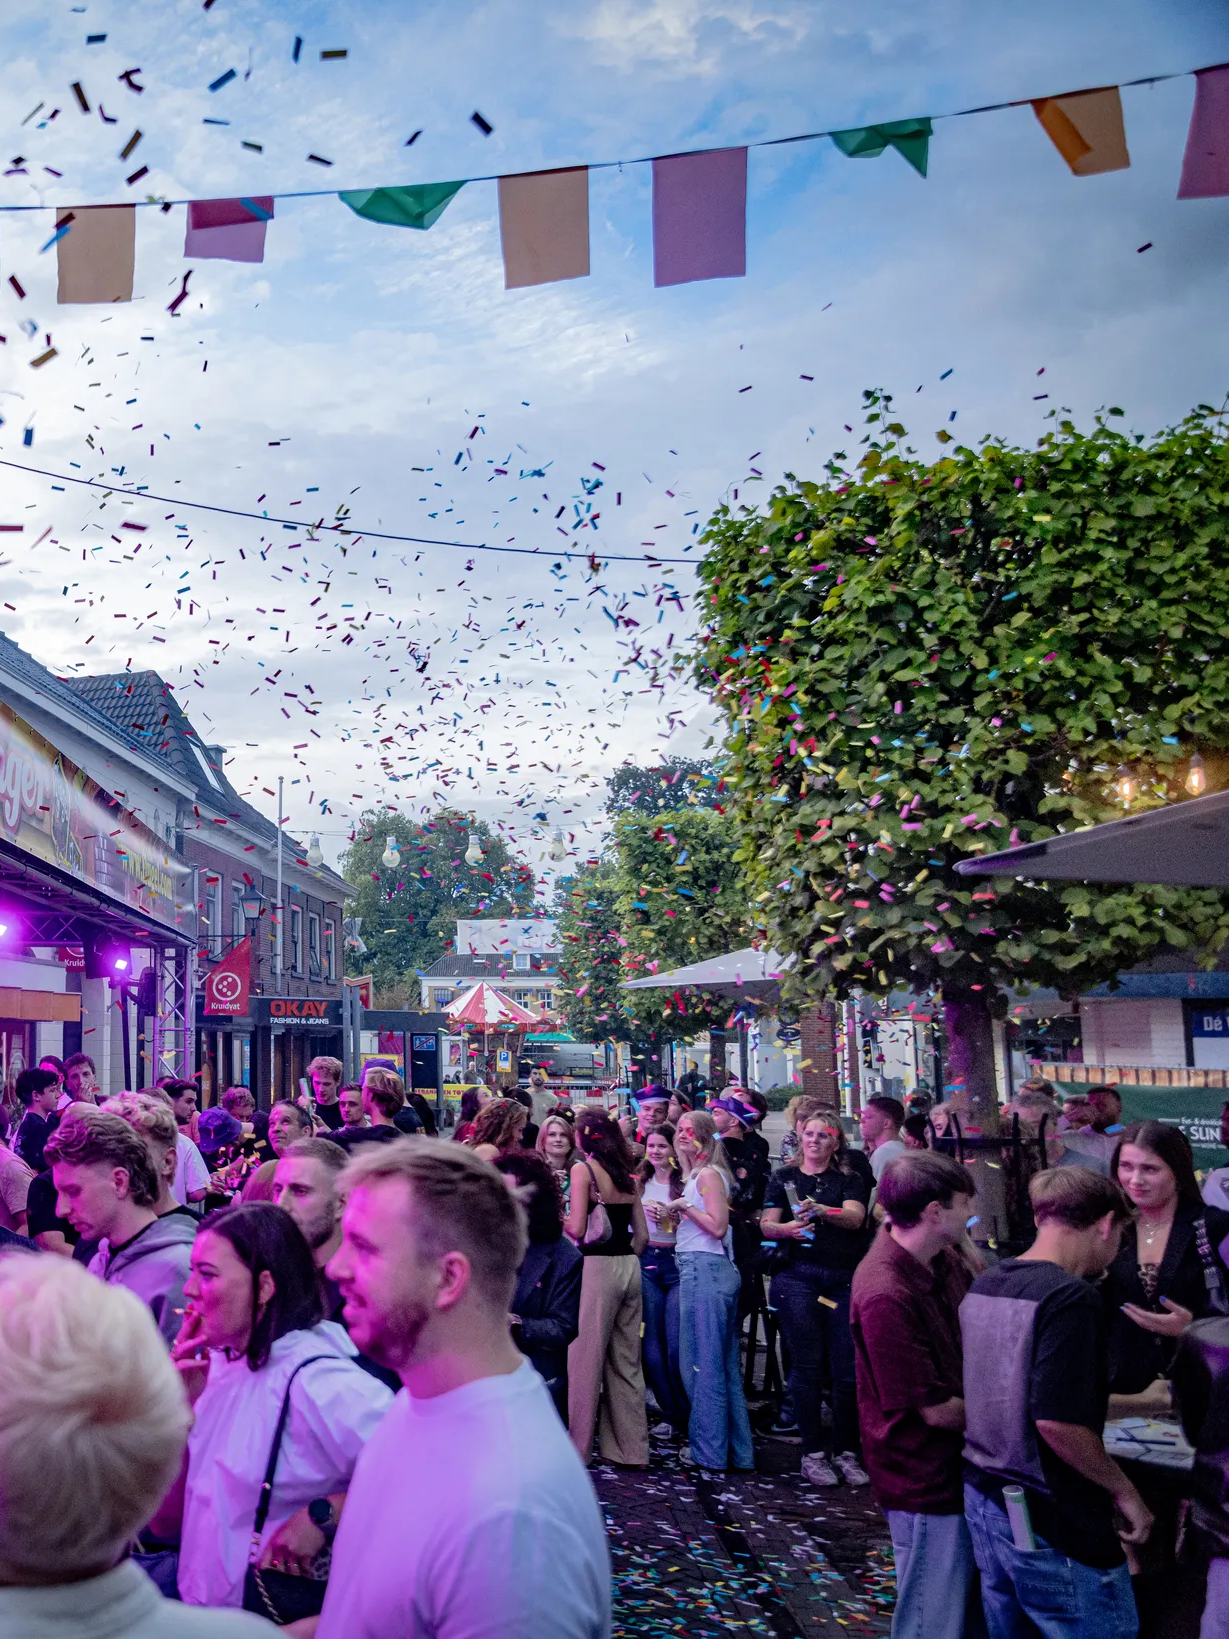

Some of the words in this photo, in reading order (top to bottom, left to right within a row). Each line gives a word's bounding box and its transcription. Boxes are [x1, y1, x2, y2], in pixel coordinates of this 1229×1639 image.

[64, 958, 86, 967] Kruid
[211, 1002, 240, 1010] Kruidvat
[270, 1000, 328, 1017] OKAY
[501, 1052, 507, 1060] P
[1189, 1126, 1221, 1141] SLIN
